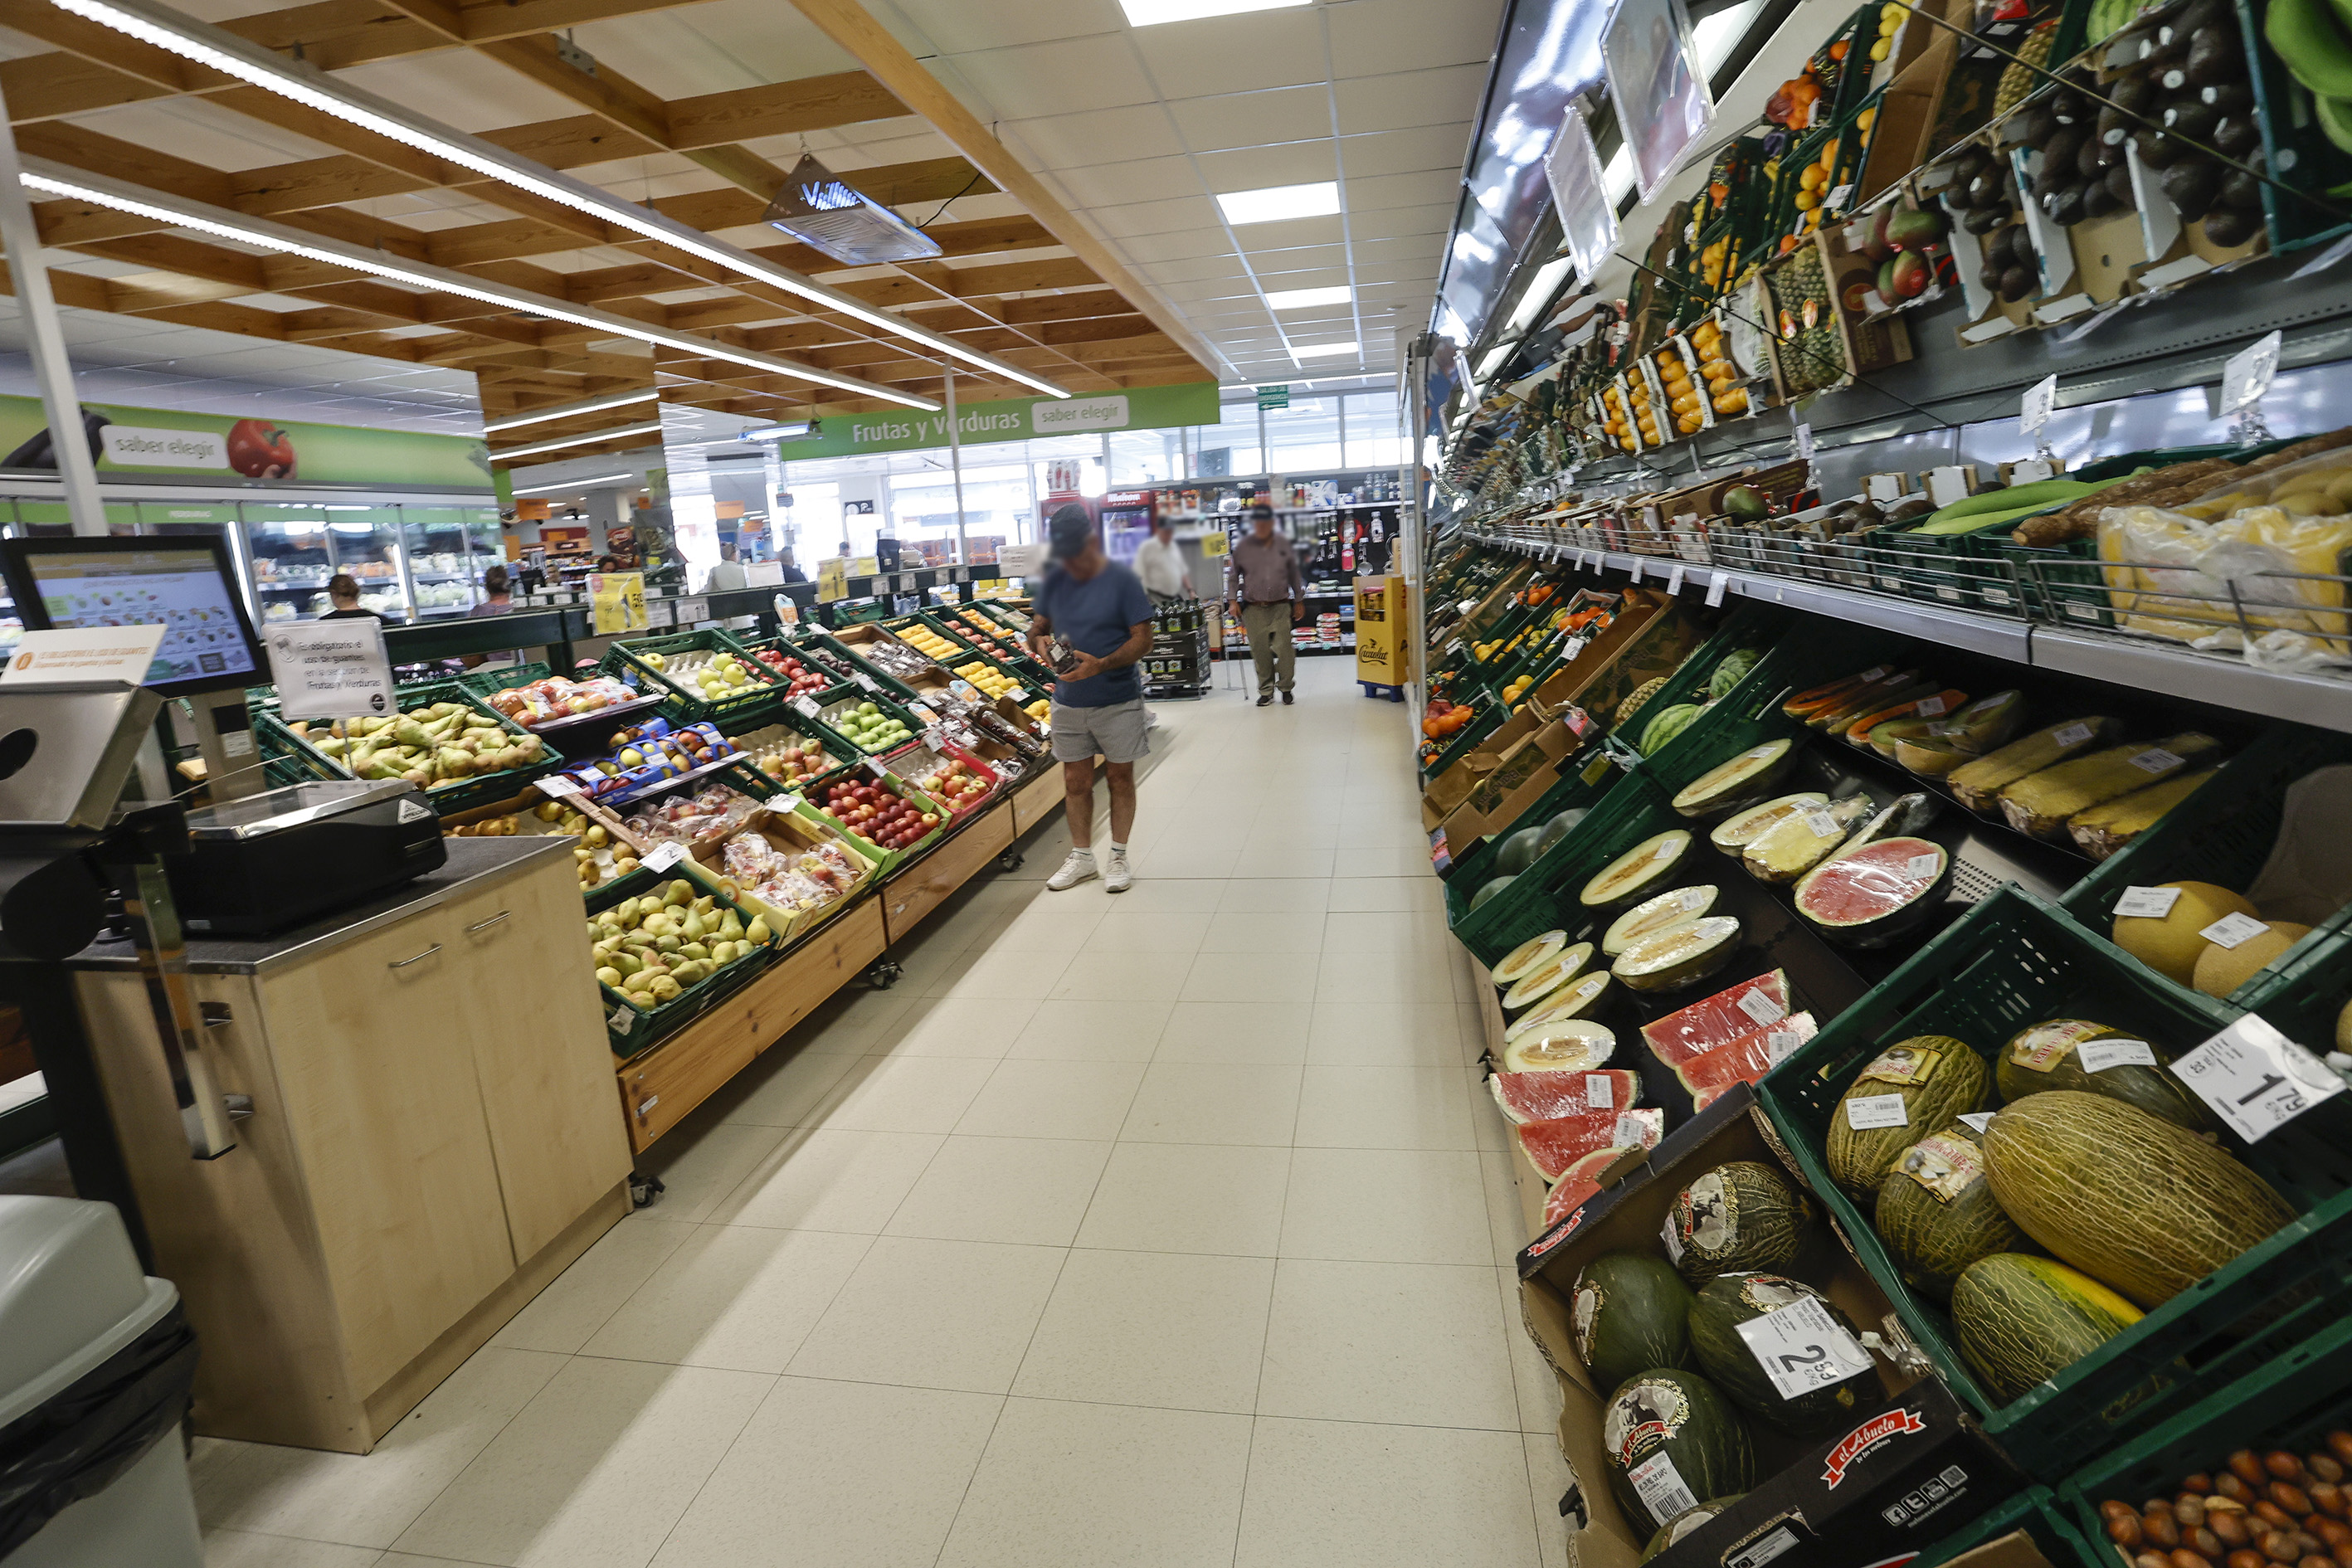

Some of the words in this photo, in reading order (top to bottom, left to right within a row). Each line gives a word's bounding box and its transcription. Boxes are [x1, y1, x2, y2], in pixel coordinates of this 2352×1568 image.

[1041, 408, 1078, 423] saber
[1080, 403, 1119, 422] elegir
[852, 420, 911, 444] Frutas
[916, 421, 928, 441] y
[115, 435, 164, 453] saber
[167, 437, 215, 460] elegir
[309, 640, 353, 651] obligatorio
[303, 655, 319, 665] uso
[332, 654, 366, 665] guantes
[345, 679, 382, 689] Verduras
[2237, 1073, 2286, 1106] 1
[1779, 1345, 1826, 1373] 2
[1633, 1424, 1658, 1442] Abuelo
[1838, 1446, 1850, 1463] el
[1849, 1418, 1896, 1452] Abuelo
[1861, 1449, 1871, 1459] los
[1869, 1439, 1892, 1453] melones
